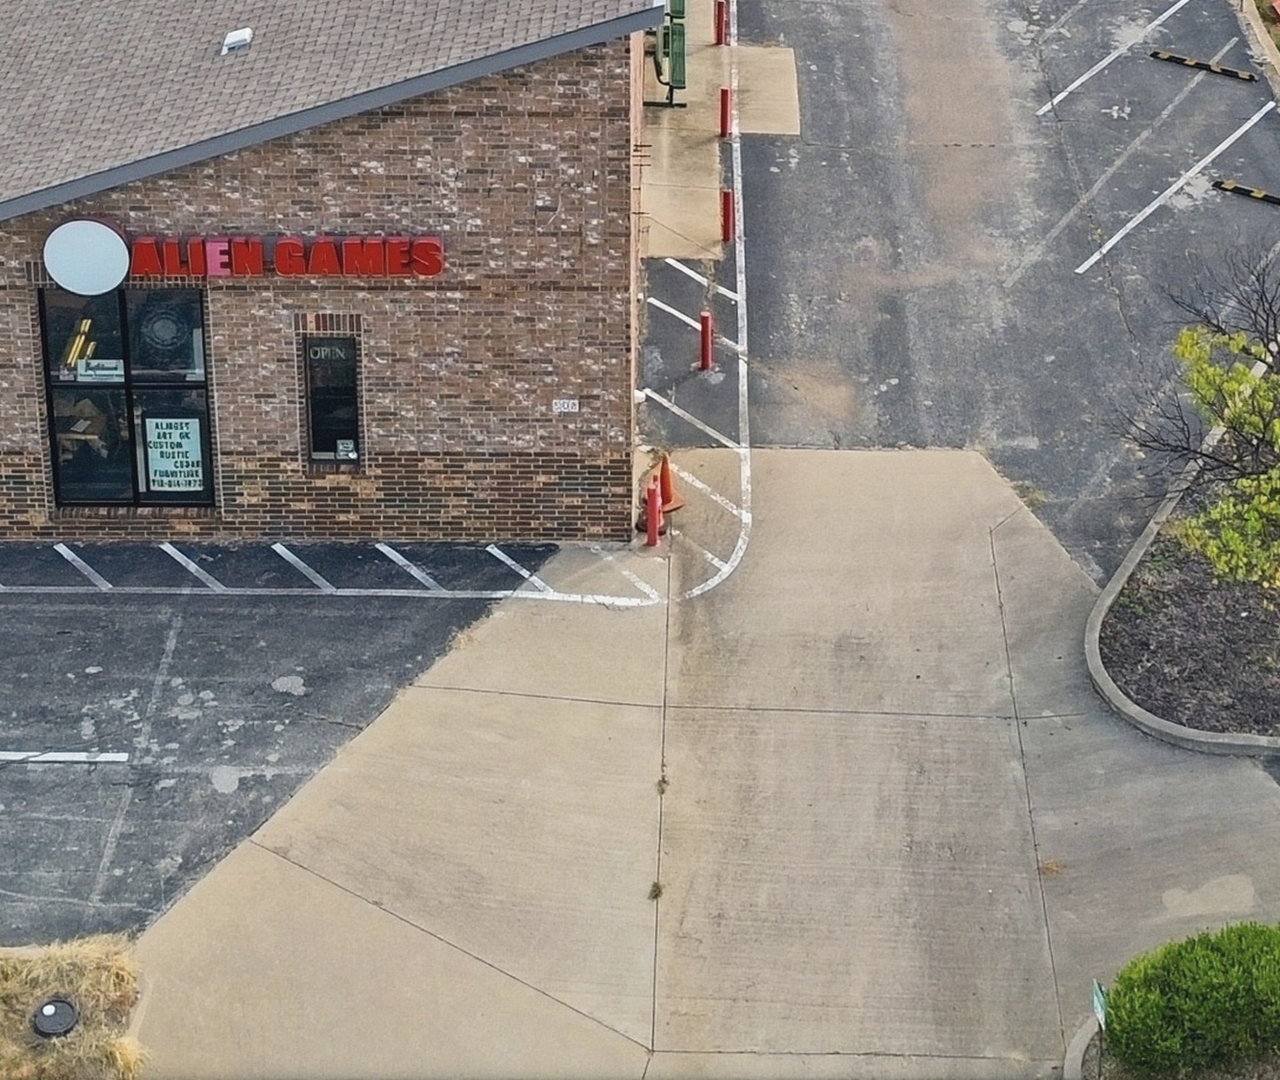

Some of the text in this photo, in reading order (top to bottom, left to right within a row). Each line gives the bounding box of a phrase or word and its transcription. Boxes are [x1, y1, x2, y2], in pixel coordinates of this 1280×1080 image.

[130, 235, 445, 279] ALIEN GAMES
[310, 346, 347, 360] OPEN
[147, 440, 184, 450] CUSTOM
